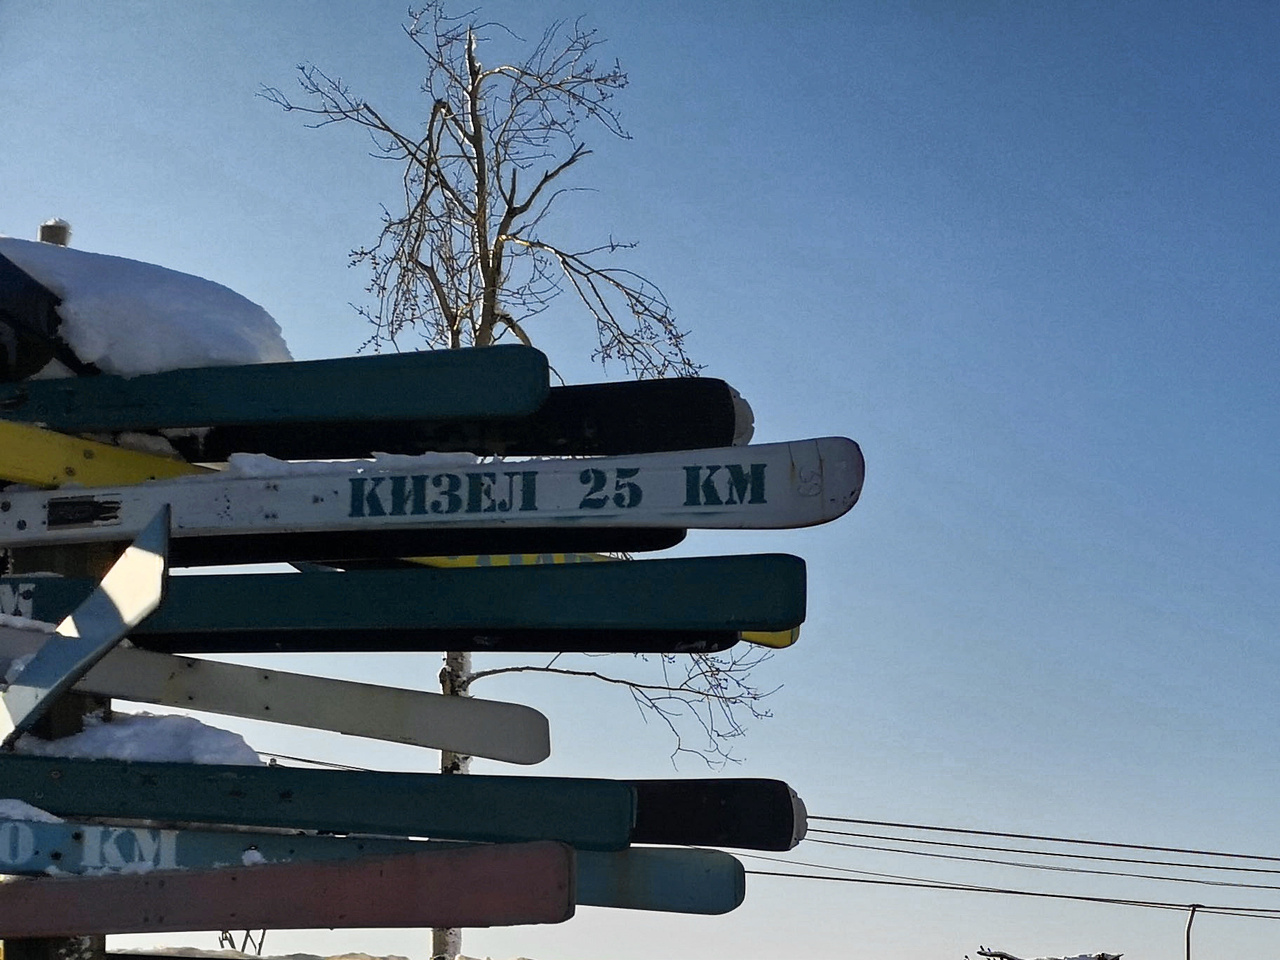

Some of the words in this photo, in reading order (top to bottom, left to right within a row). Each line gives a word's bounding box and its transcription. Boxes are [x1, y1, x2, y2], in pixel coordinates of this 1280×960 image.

[348, 470, 539, 517] КИЗЕЛ
[579, 467, 643, 509] 25
[682, 463, 768, 506] КМ
[81, 825, 188, 870] КМ
